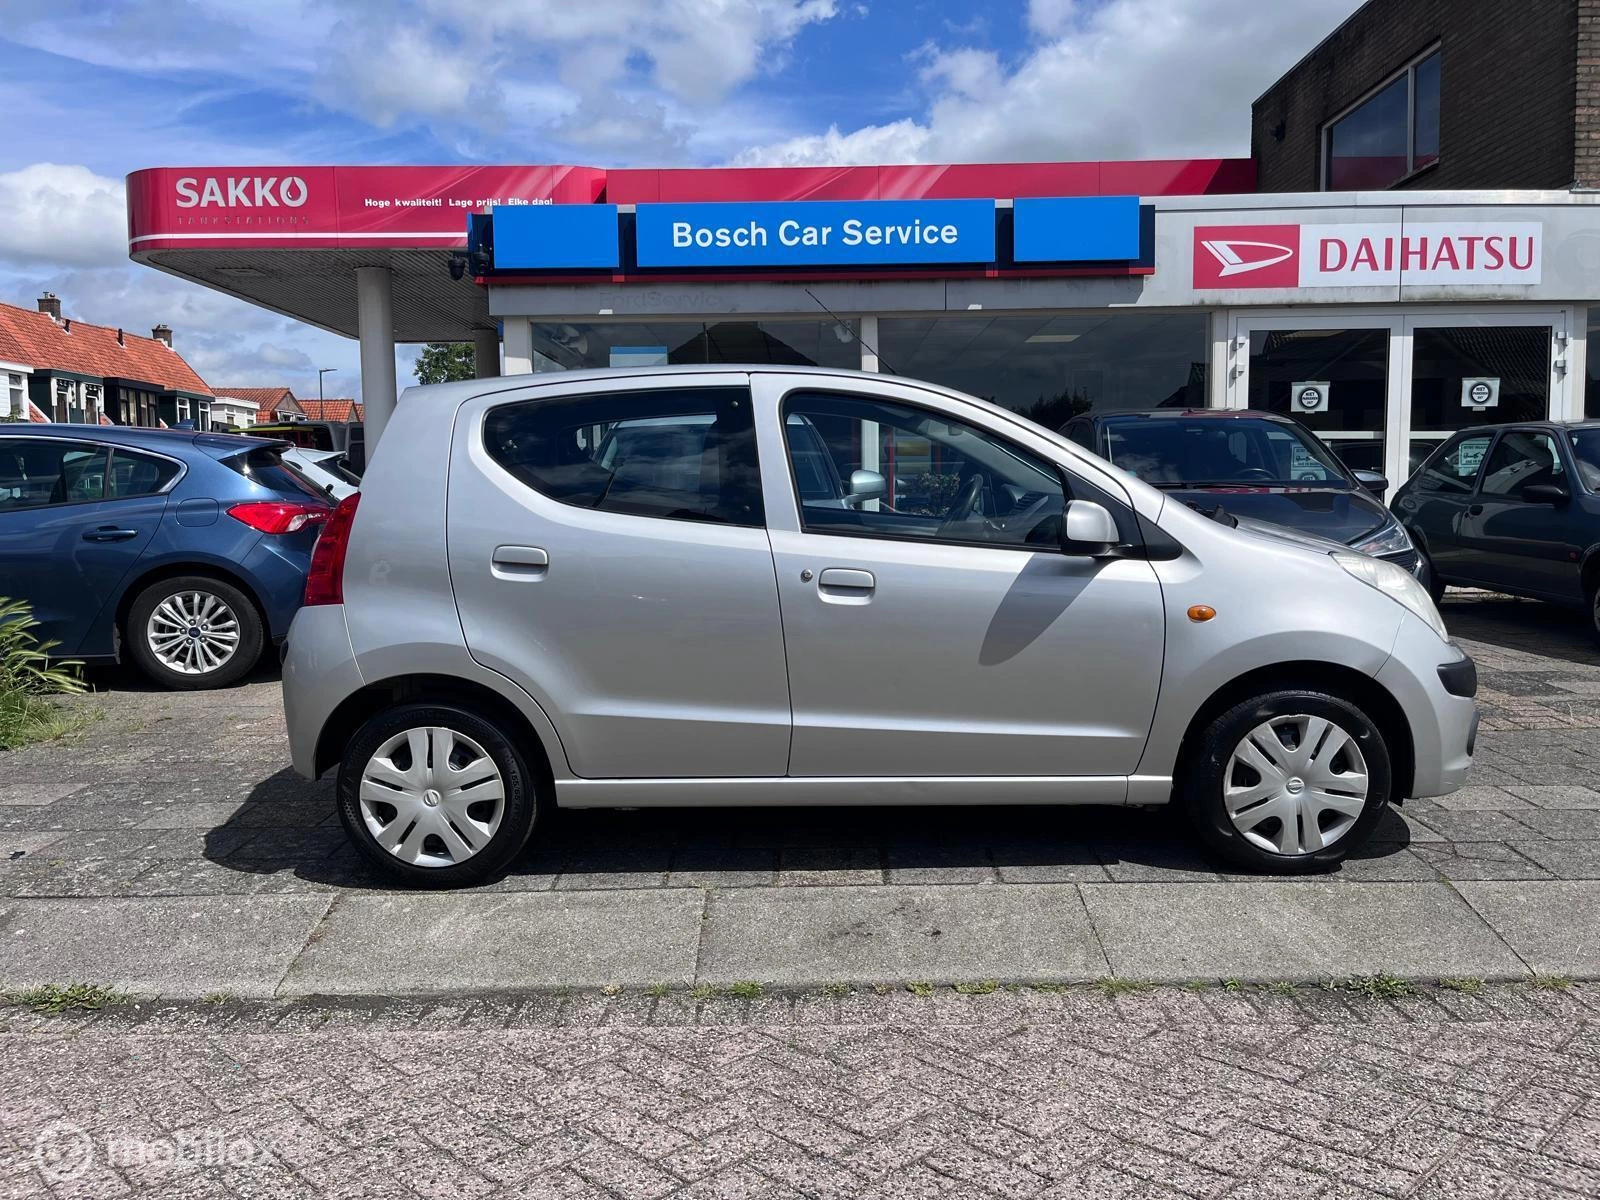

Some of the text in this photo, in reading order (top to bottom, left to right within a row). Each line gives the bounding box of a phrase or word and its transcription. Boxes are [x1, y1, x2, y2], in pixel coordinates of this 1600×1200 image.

[175, 176, 308, 208] SAKKO
[364, 198, 391, 208] Hoge
[394, 198, 442, 207] kwaliteit!
[448, 198, 473, 208] Lage
[476, 198, 501, 208] prijs!
[508, 198, 529, 206] Elke
[177, 215, 310, 225] TANKSTATIONS
[672, 219, 959, 248] Bosch Car Service
[1319, 236, 1534, 273] DAIHATSU
